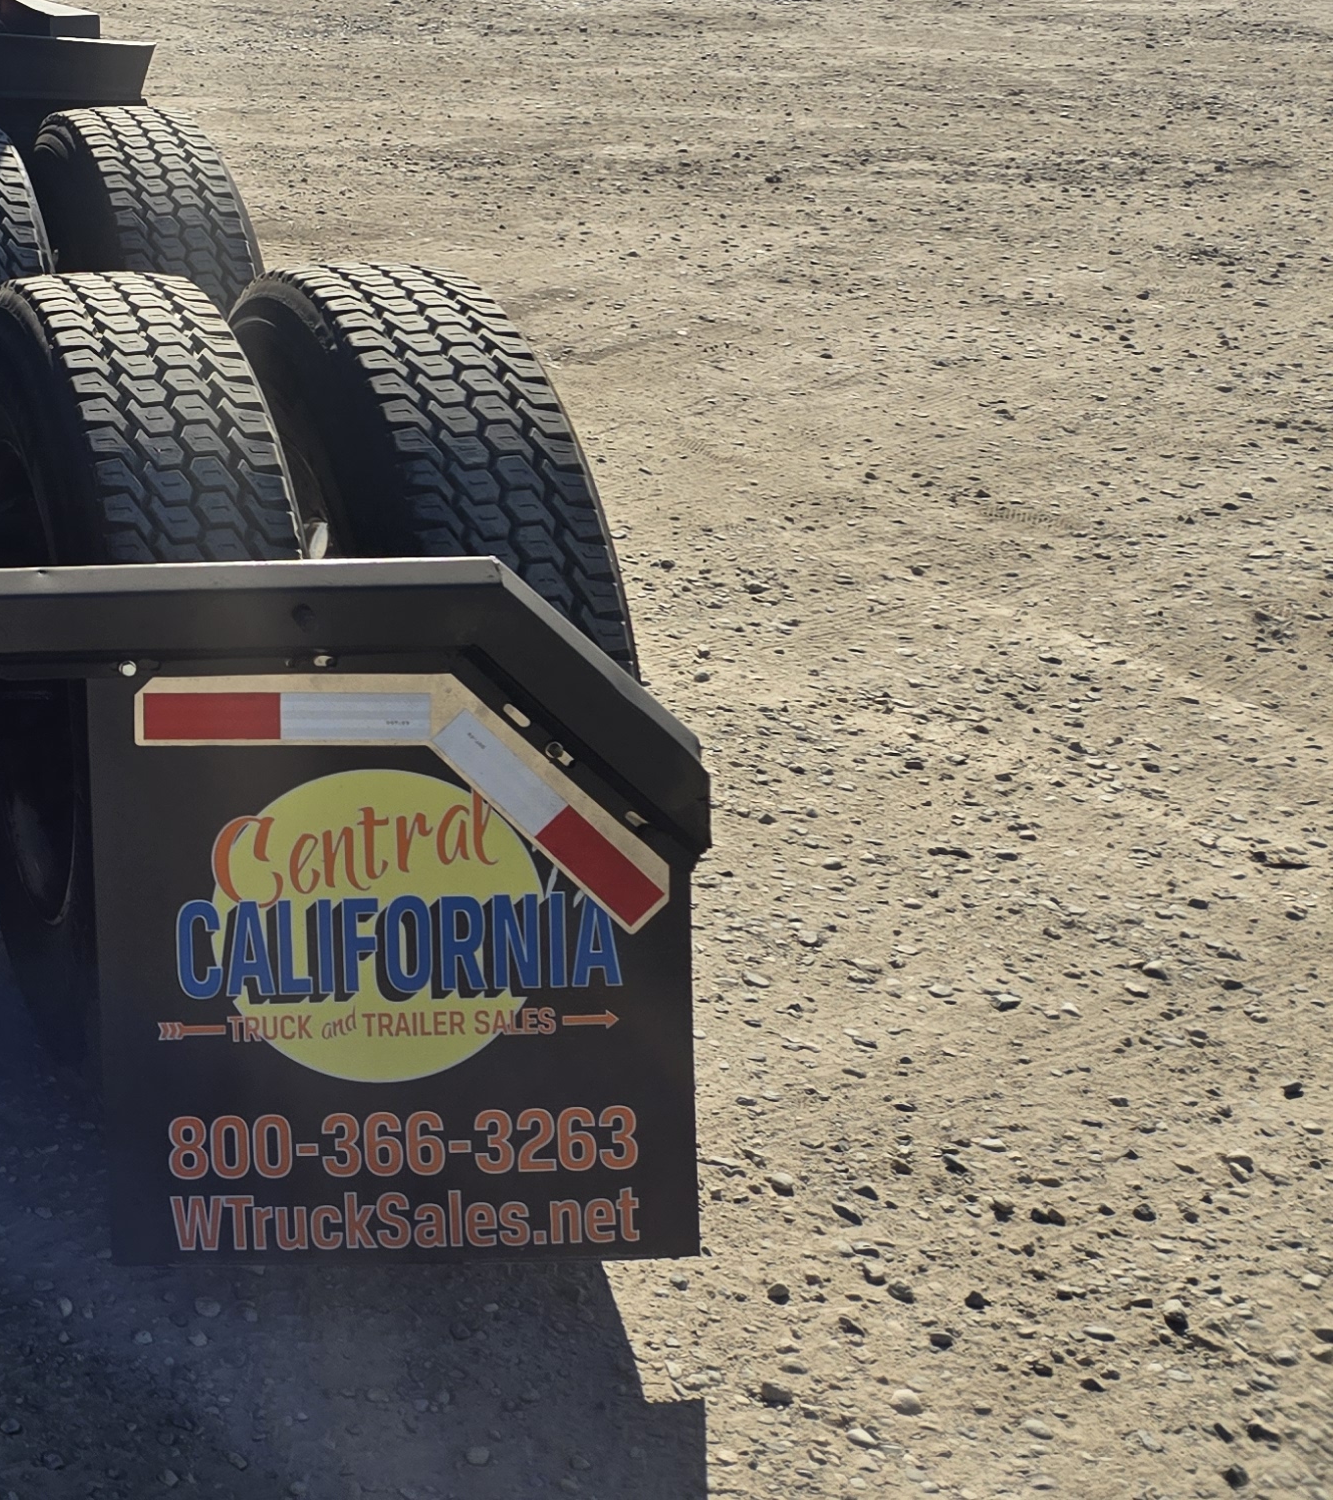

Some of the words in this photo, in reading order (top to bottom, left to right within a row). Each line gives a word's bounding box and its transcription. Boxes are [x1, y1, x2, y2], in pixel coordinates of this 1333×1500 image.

[211, 788, 499, 908] Central
[176, 891, 624, 1002] CALIFORNIA
[226, 1014, 313, 1043] TRUCK
[321, 1006, 358, 1041] and
[362, 1011, 467, 1039] TRAILER
[474, 1007, 557, 1037] SALES
[168, 1105, 639, 1180] 800-366-3263
[170, 1187, 641, 1252] WTruckSales.net
